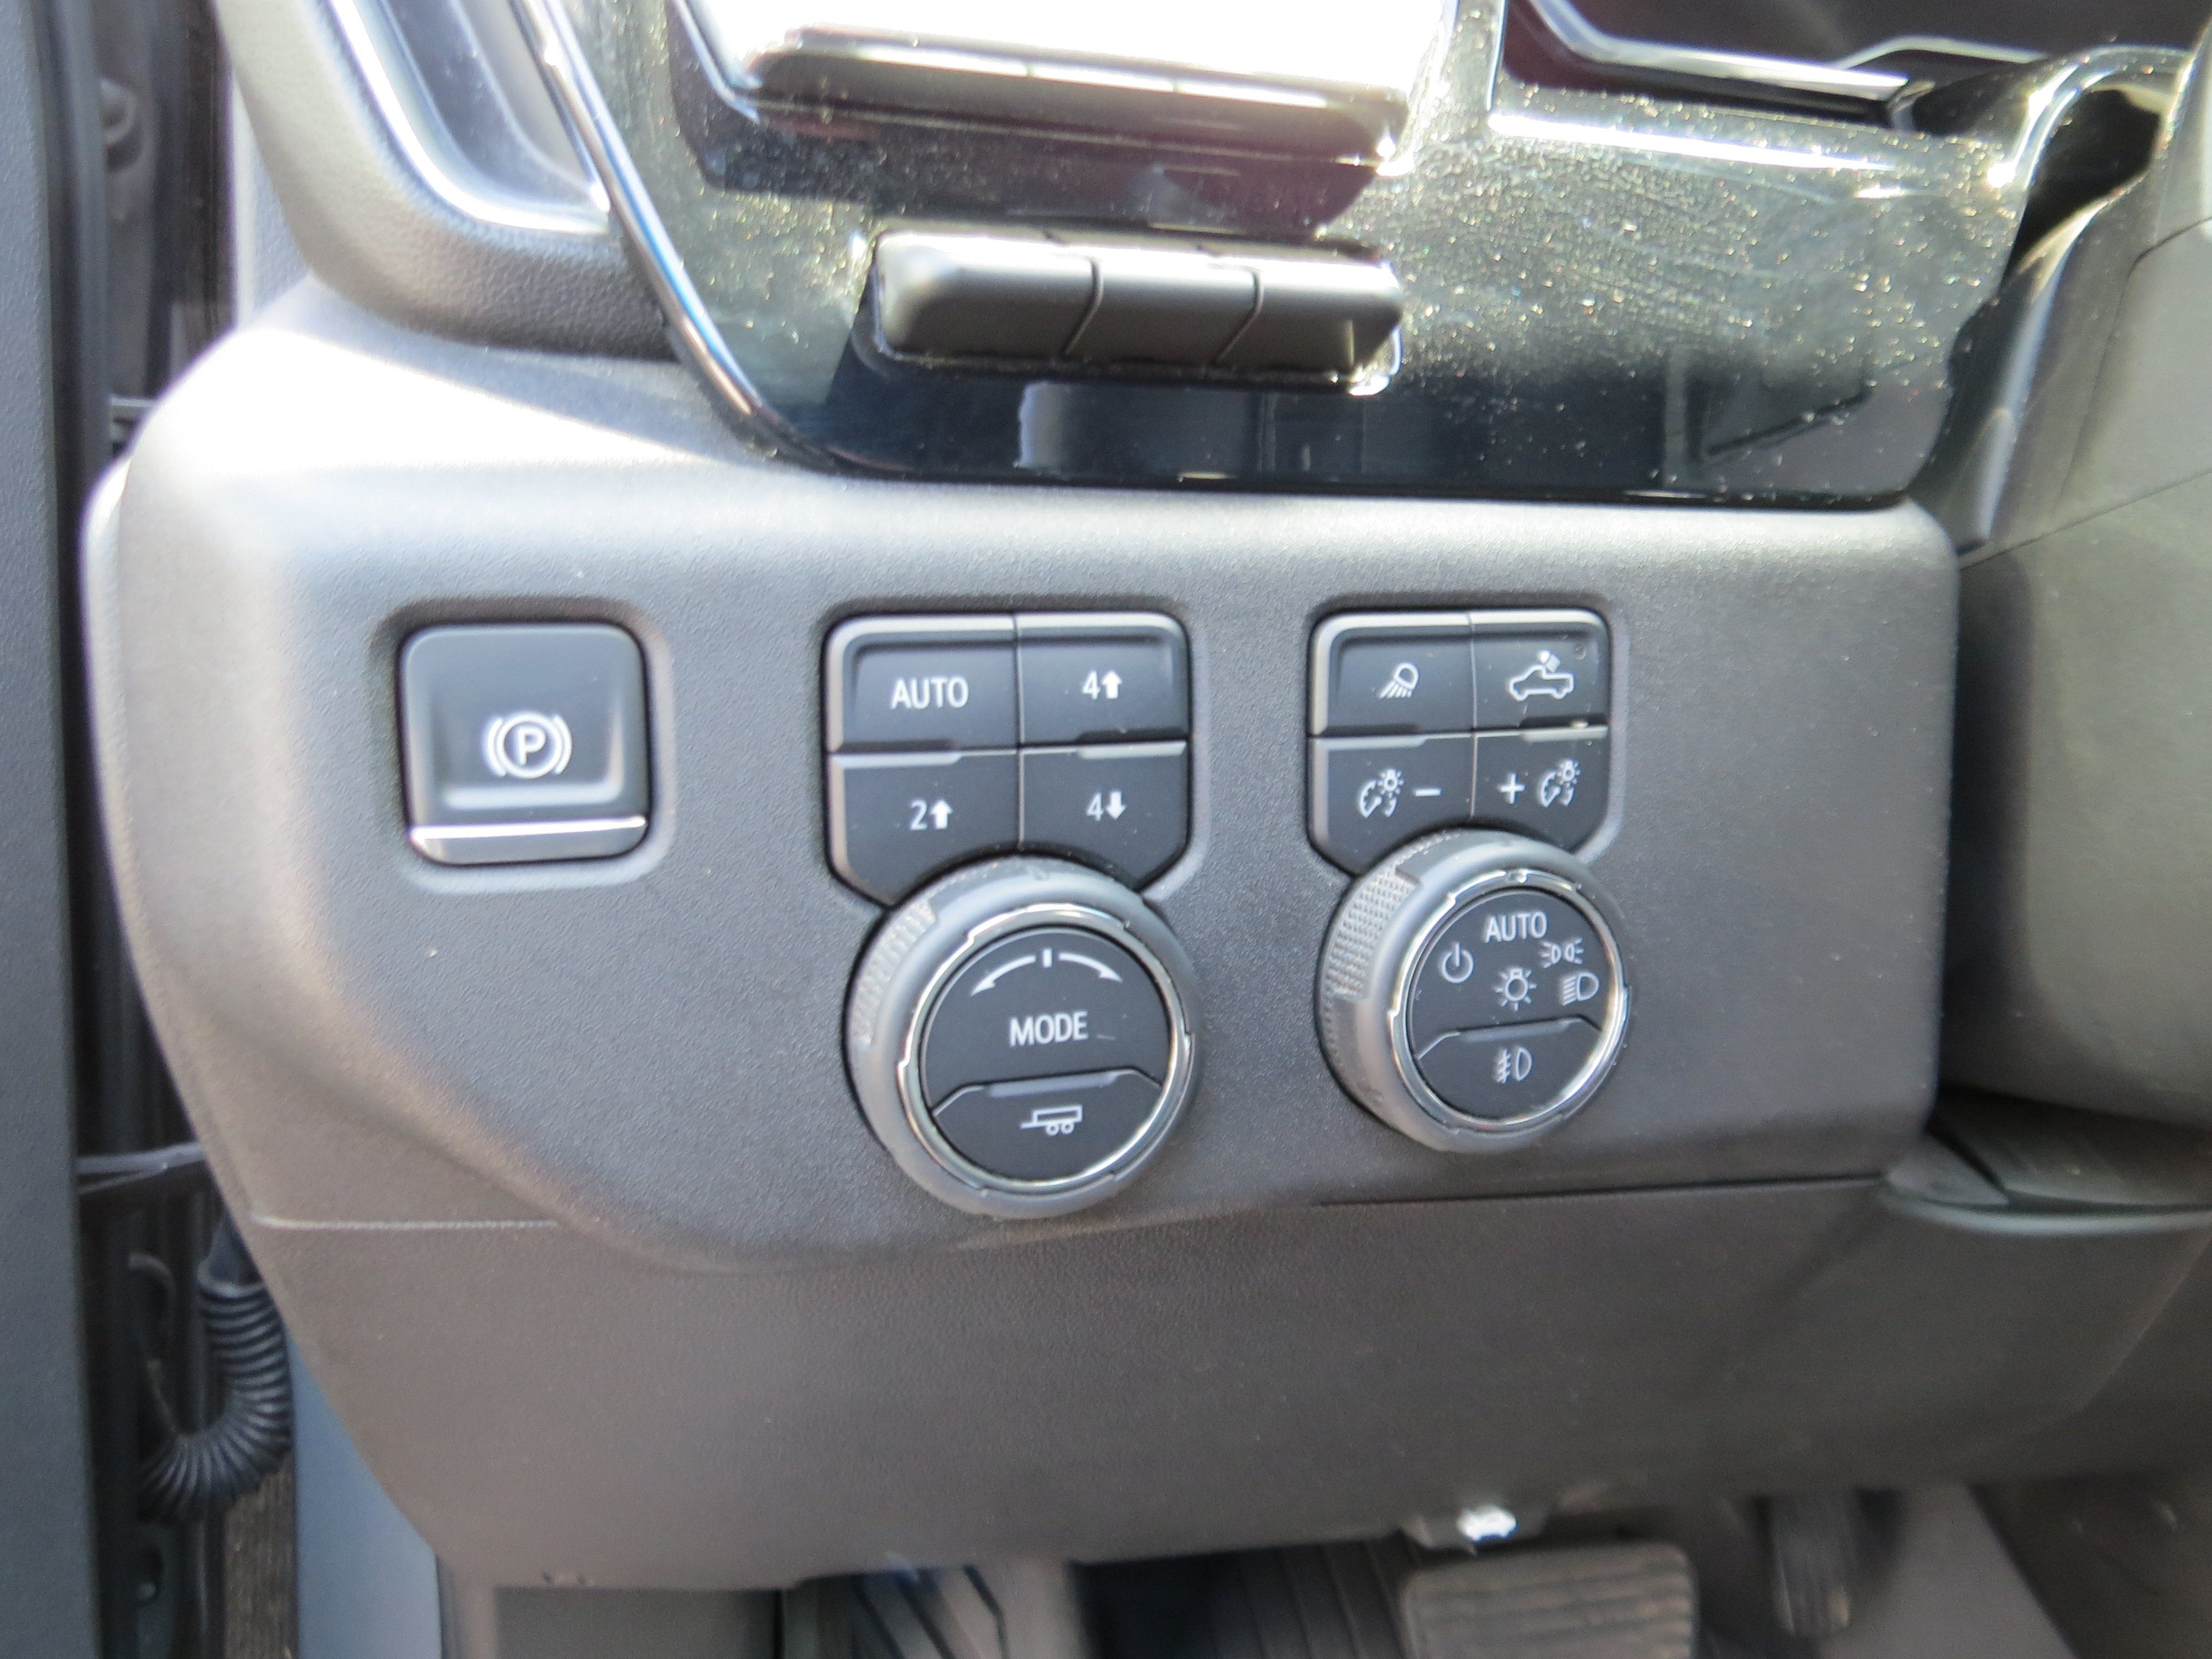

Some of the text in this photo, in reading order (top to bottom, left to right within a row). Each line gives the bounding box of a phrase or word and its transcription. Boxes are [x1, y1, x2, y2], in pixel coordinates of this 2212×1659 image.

[891, 675, 969, 709] AUTO
[1082, 670, 1101, 701] 4
[515, 727, 547, 766] P
[910, 800, 927, 831] 2
[1086, 792, 1103, 822] 4
[1485, 911, 1547, 943] AUTO
[1009, 1011, 1088, 1047] MODE
